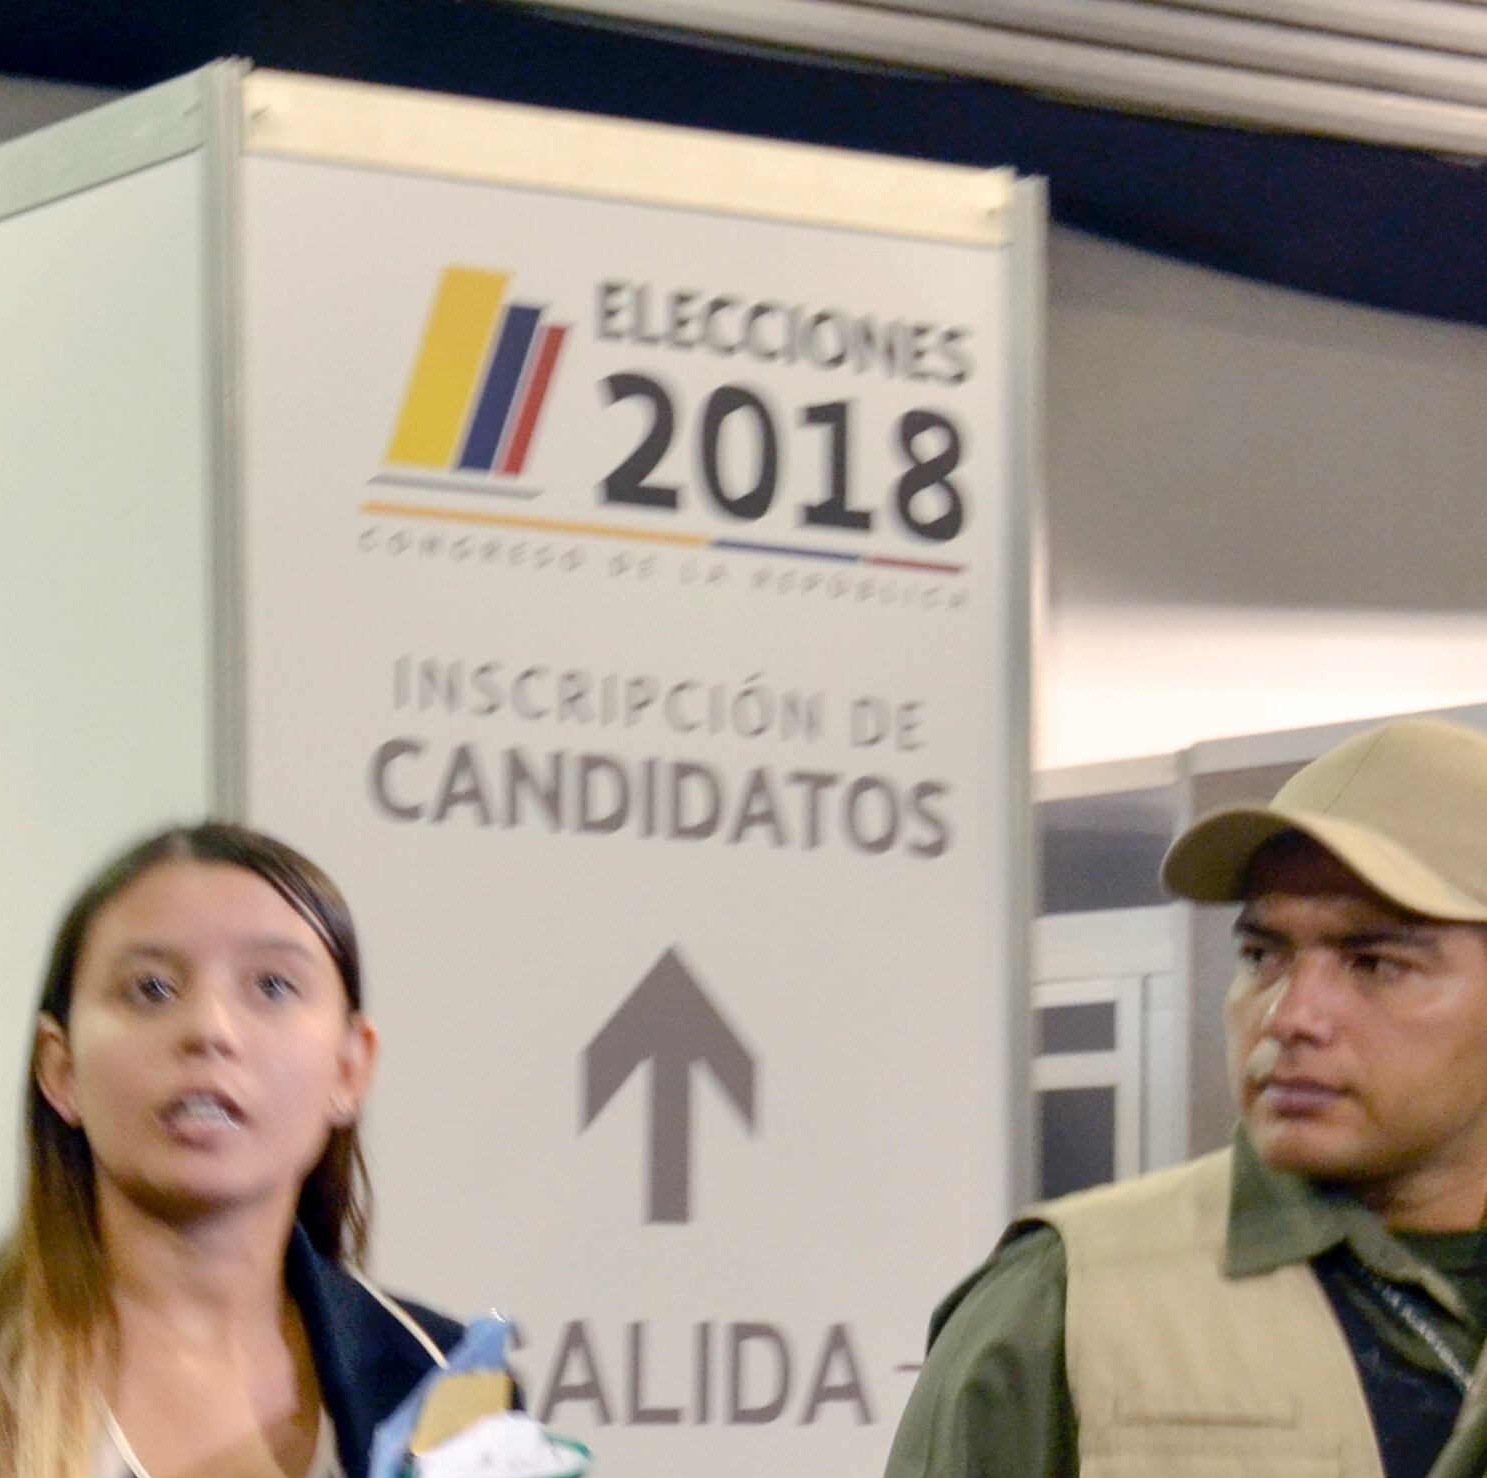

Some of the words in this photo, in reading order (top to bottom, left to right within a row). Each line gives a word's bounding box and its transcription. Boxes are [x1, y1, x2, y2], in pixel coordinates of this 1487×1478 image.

[594, 279, 973, 387] ELECCIONES
[596, 371, 967, 543] 2018
[391, 655, 823, 745] INSCRIPCIÓN
[848, 696, 930, 752] DE
[366, 736, 955, 861] CANDIDATOS
[512, 1318, 874, 1427] ALIDA
